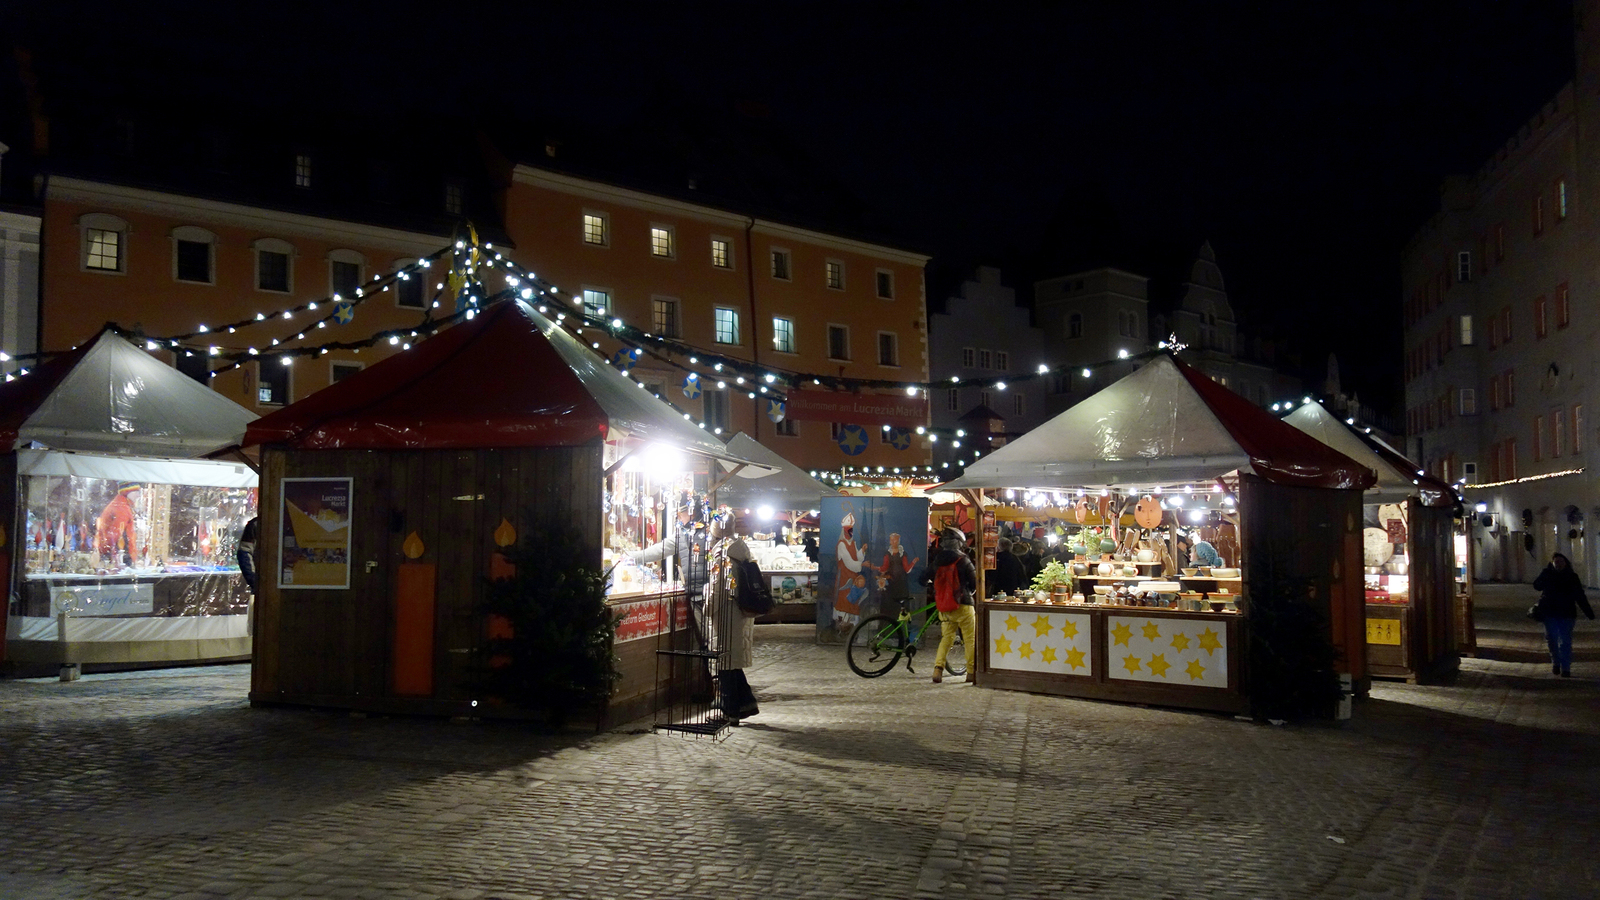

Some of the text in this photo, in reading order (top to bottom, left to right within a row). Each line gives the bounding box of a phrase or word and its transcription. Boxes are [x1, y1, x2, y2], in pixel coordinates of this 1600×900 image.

[790, 399, 837, 411] Willkommen
[853, 402, 895, 416] Lucrezia
[895, 405, 923, 417] Markt
[322, 494, 346, 502] Lucrezia
